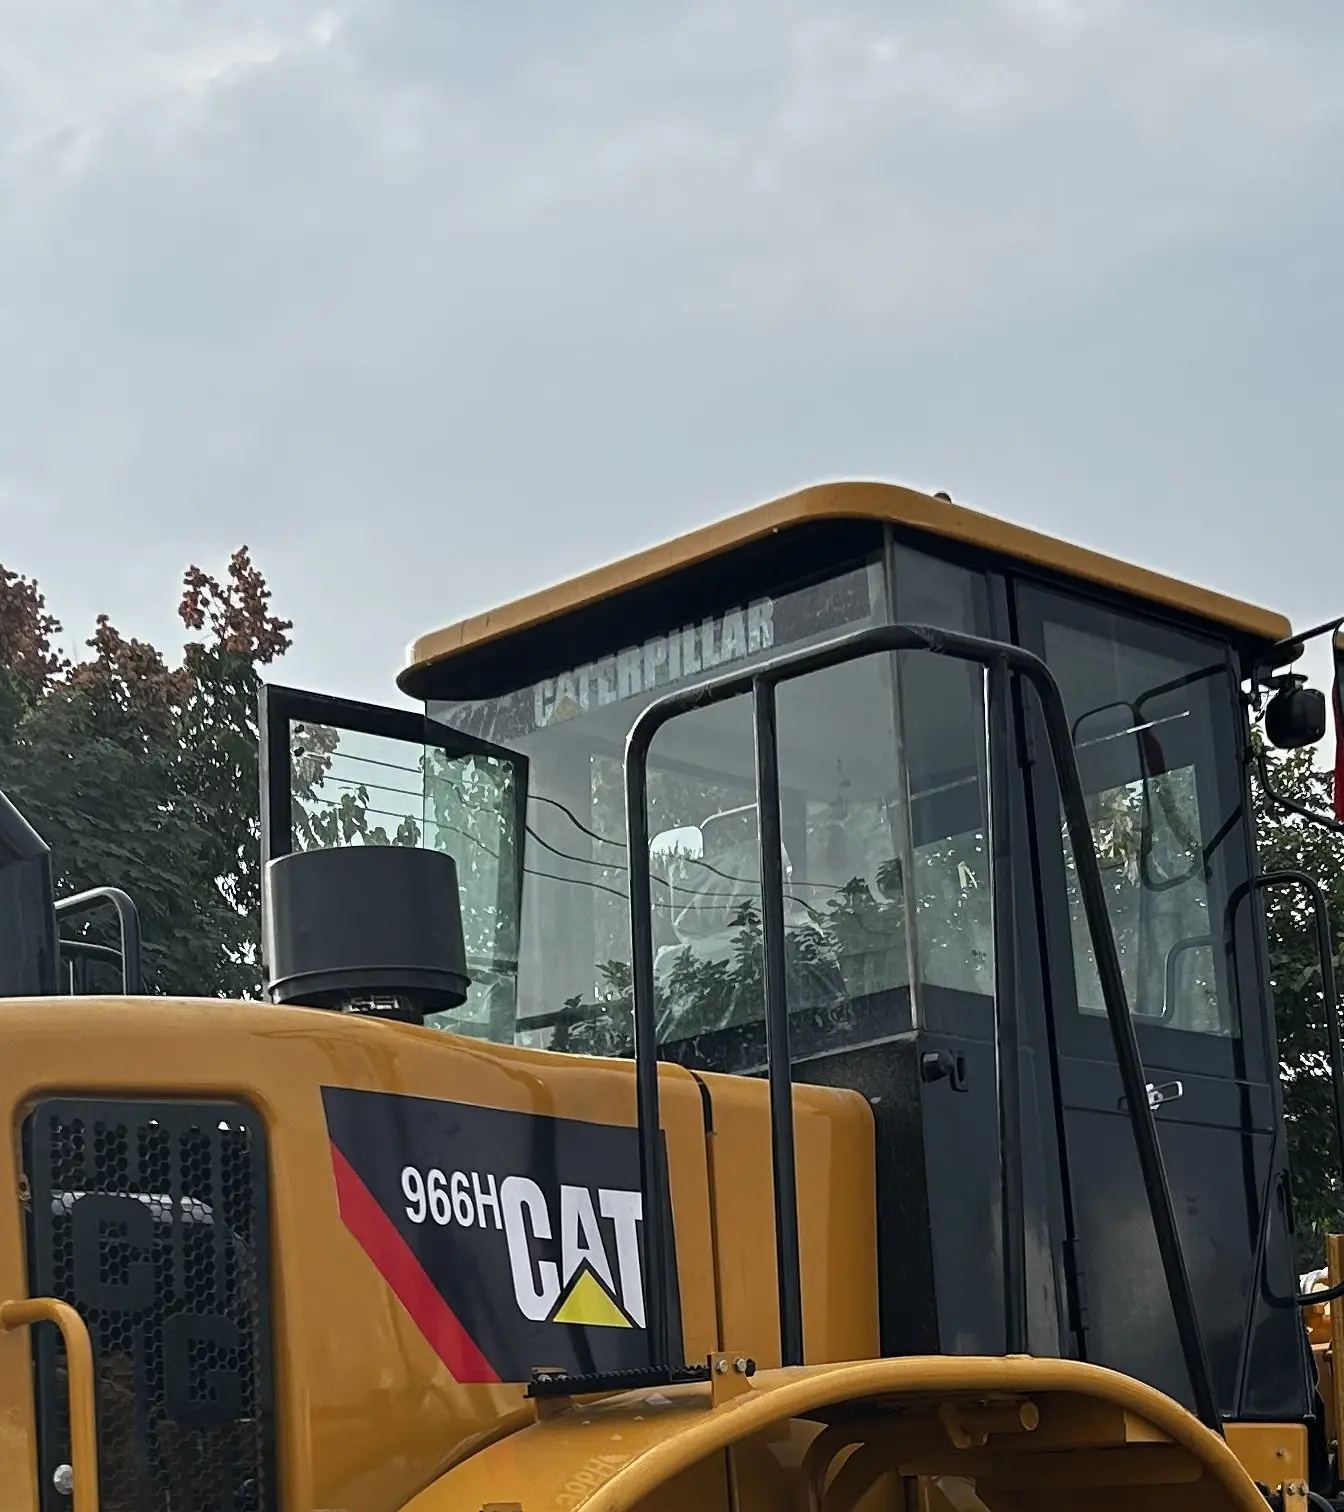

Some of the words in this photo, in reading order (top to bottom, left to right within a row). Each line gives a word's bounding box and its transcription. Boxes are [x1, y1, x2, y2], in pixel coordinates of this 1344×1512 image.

[532, 596, 775, 728] CATERPILLAR
[401, 1166, 503, 1230] 966H
[500, 1175, 646, 1329] CAT
